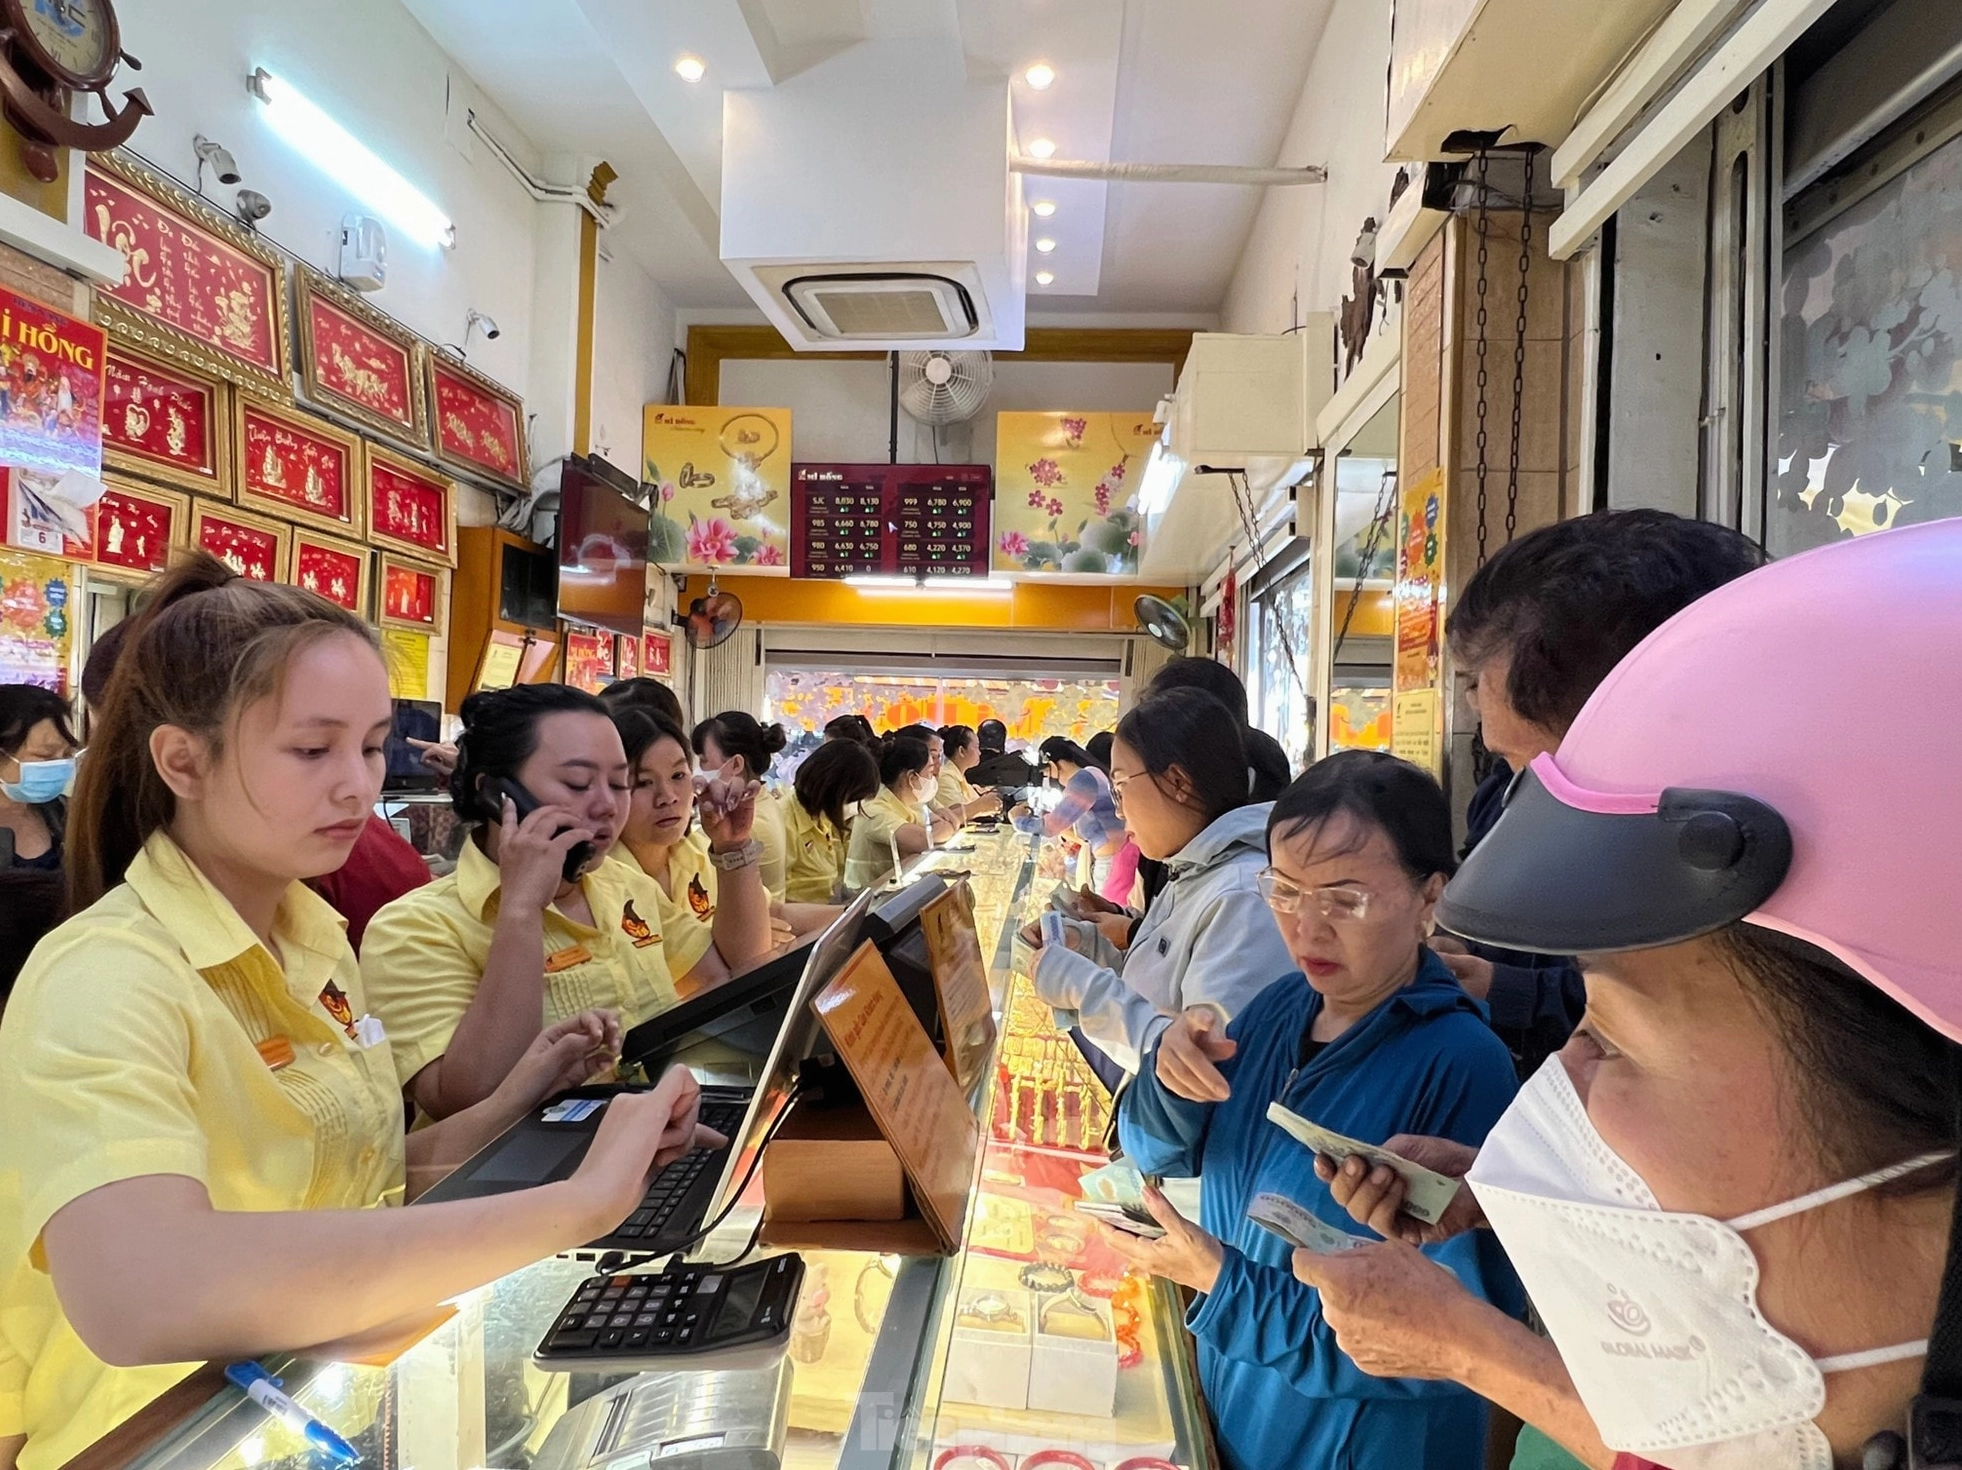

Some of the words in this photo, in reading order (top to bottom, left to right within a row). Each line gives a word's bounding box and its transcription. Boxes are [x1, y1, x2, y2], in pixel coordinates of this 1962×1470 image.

[18, 321, 94, 370] HỒNG
[812, 497, 825, 505] SJC
[860, 498, 879, 506] 8,130
[904, 498, 917, 506] 999
[952, 498, 972, 507] 6,900
[904, 520, 918, 528] 750
[952, 522, 972, 530] 4,900
[38, 532, 46, 544] 6
[860, 542, 879, 550] 6,750
[834, 564, 854, 572] 6,410
